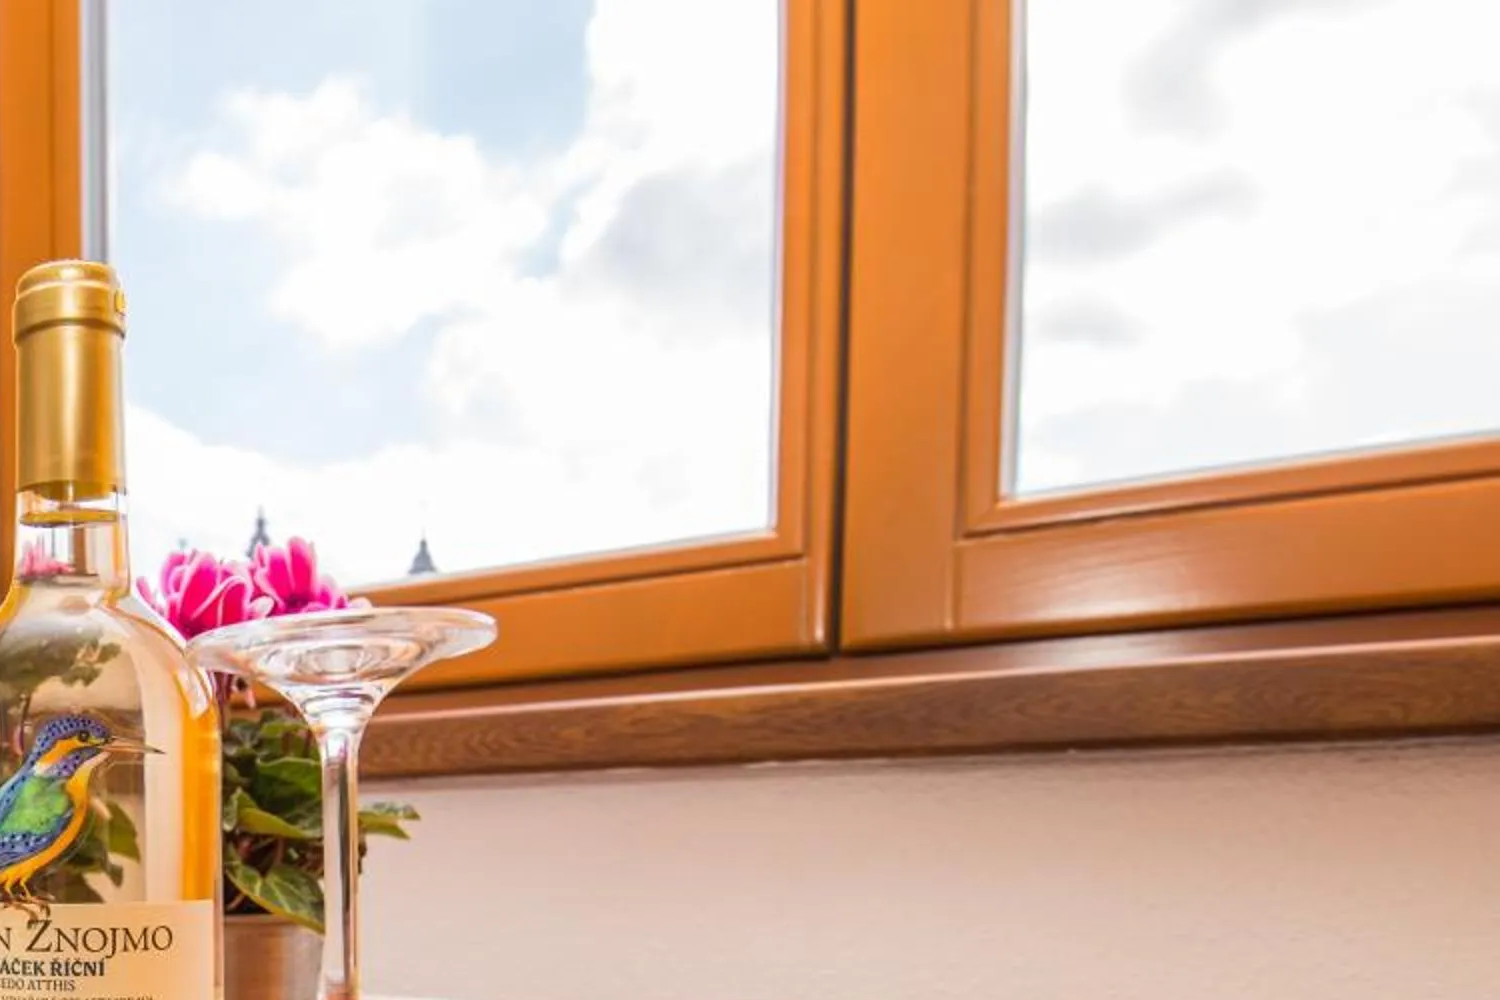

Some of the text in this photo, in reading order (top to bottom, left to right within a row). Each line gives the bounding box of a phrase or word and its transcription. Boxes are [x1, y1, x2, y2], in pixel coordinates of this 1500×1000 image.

[25, 919, 174, 959] ZNOJMO
[50, 957, 105, 977] ŘÍČNÍ
[27, 979, 76, 992] ATTHIS
